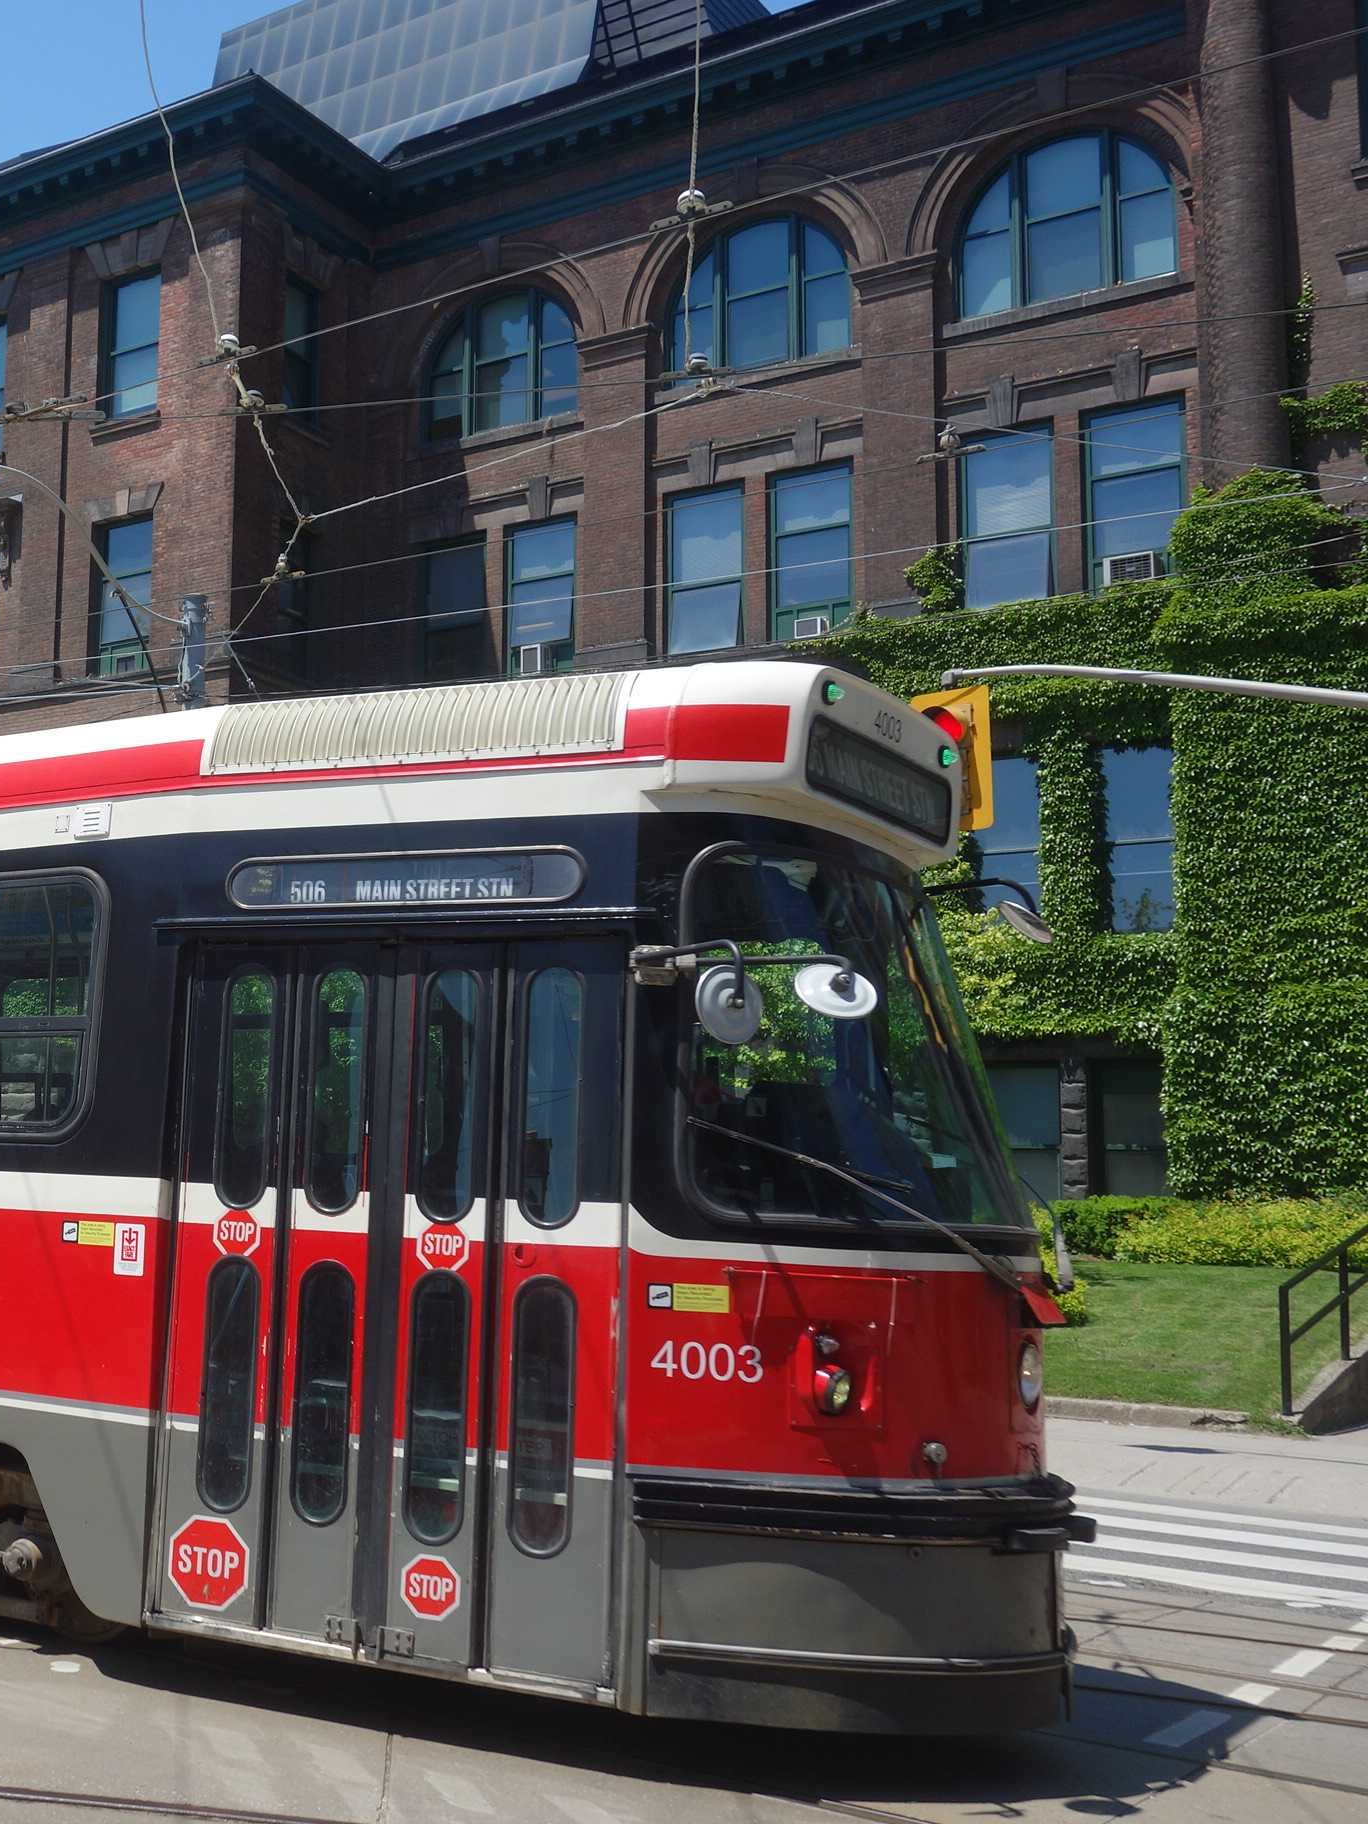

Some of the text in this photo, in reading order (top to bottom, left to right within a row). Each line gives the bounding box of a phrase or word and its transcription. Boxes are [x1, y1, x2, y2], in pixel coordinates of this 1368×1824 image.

[874, 710, 903, 743] 4003
[290, 877, 514, 903] 506 MAIN STREET STN
[219, 1220, 255, 1242] STOP
[424, 1232, 463, 1256] STOP
[650, 1340, 764, 1383] 4003
[178, 1544, 240, 1580] STOP
[409, 1572, 454, 1602] STOP
